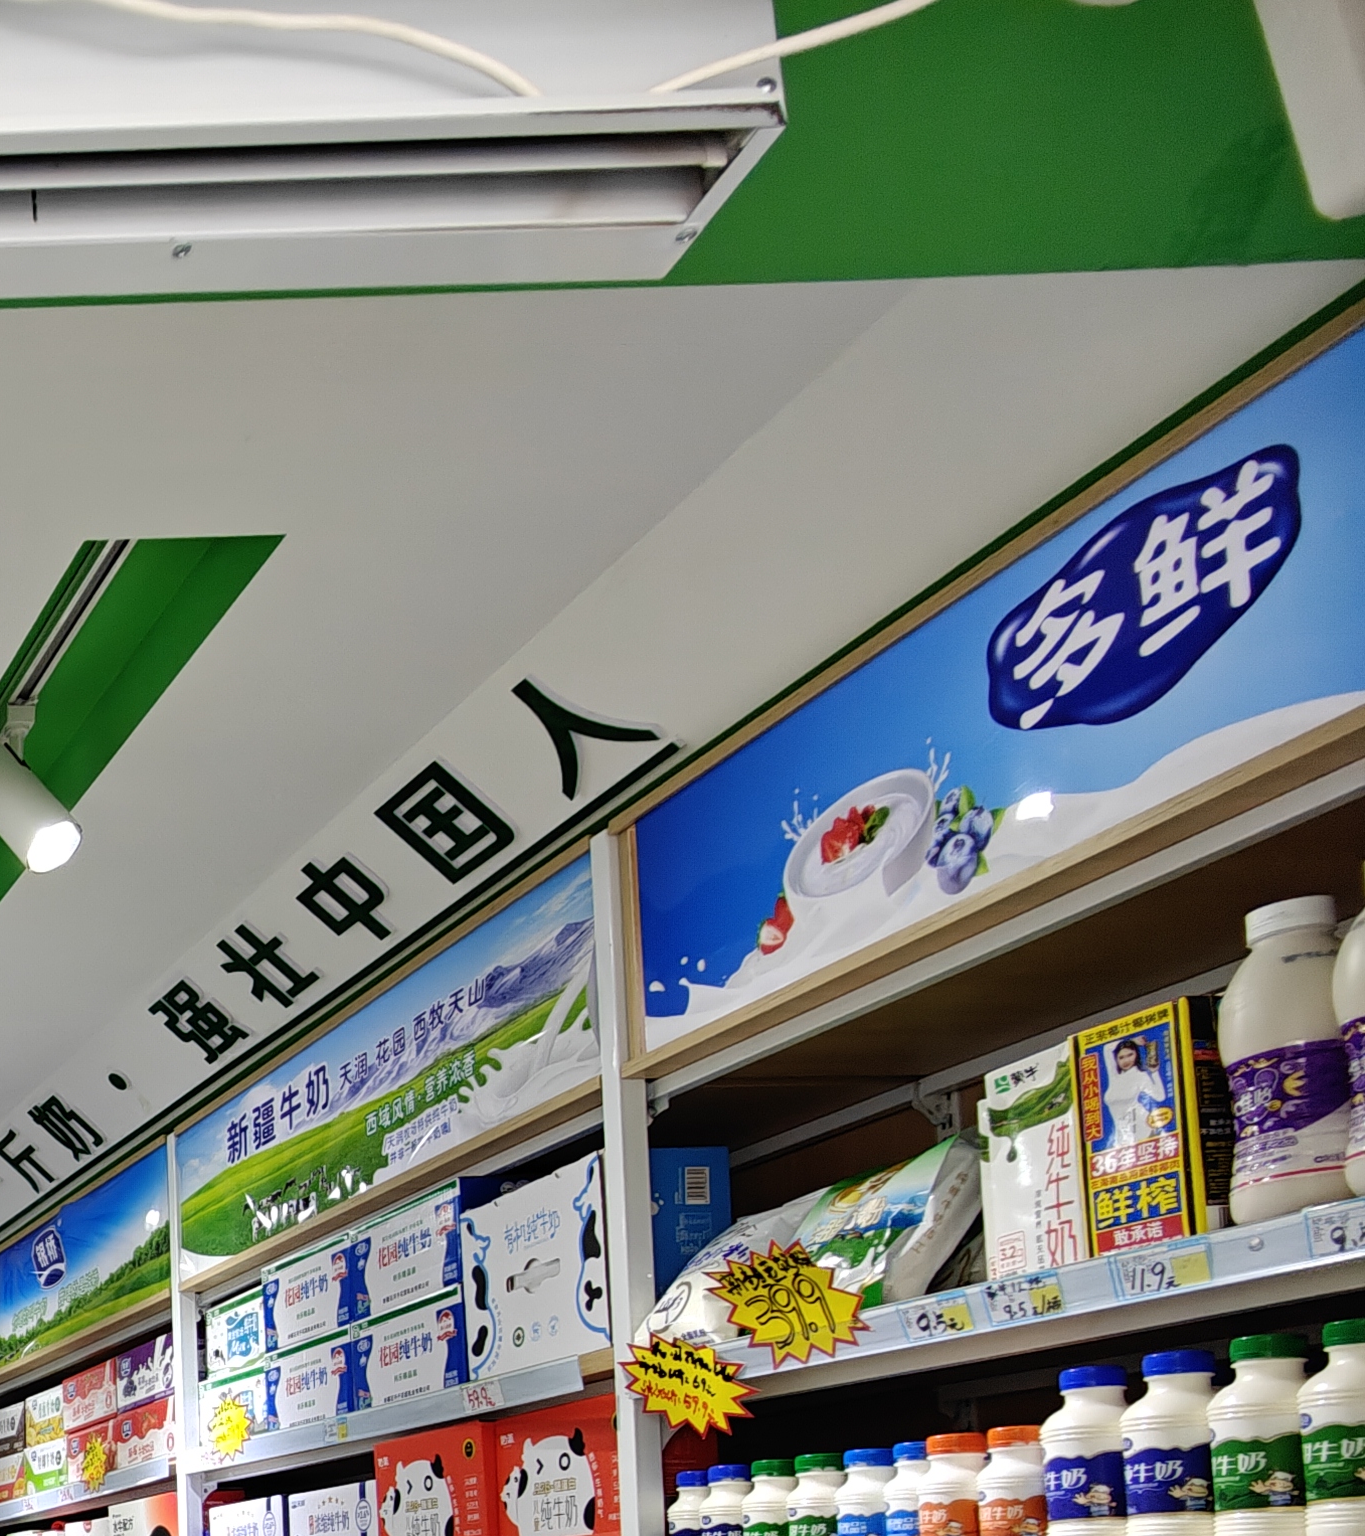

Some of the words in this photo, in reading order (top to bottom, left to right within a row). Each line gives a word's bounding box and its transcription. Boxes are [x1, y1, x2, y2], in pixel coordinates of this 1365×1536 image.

[1014, 459, 1281, 731] 多鲜
[1083, 1008, 1171, 1046] 正宗椰汁椰树牌
[226, 1065, 330, 1164] 新疆牛奶
[338, 1052, 368, 1091] 天润
[375, 1026, 406, 1063] 花园
[413, 977, 487, 1042] 西牧天山
[1010, 1063, 1040, 1089] 蒙牛
[1081, 1055, 1101, 1141] 我从小喝到大
[1091, 1136, 1180, 1178] 36年坚持
[1094, 1178, 1180, 1228] 鲜榨
[377, 1228, 432, 1268] 花园纯牛奶
[503, 1209, 561, 1254] 有机纯牛奶
[1113, 1221, 1165, 1247] 敢承诺
[284, 1273, 329, 1308] 花园纯牛奶
[379, 1332, 433, 1369] 花园纯牛奶
[285, 1362, 328, 1398] 花园纯牛奶
